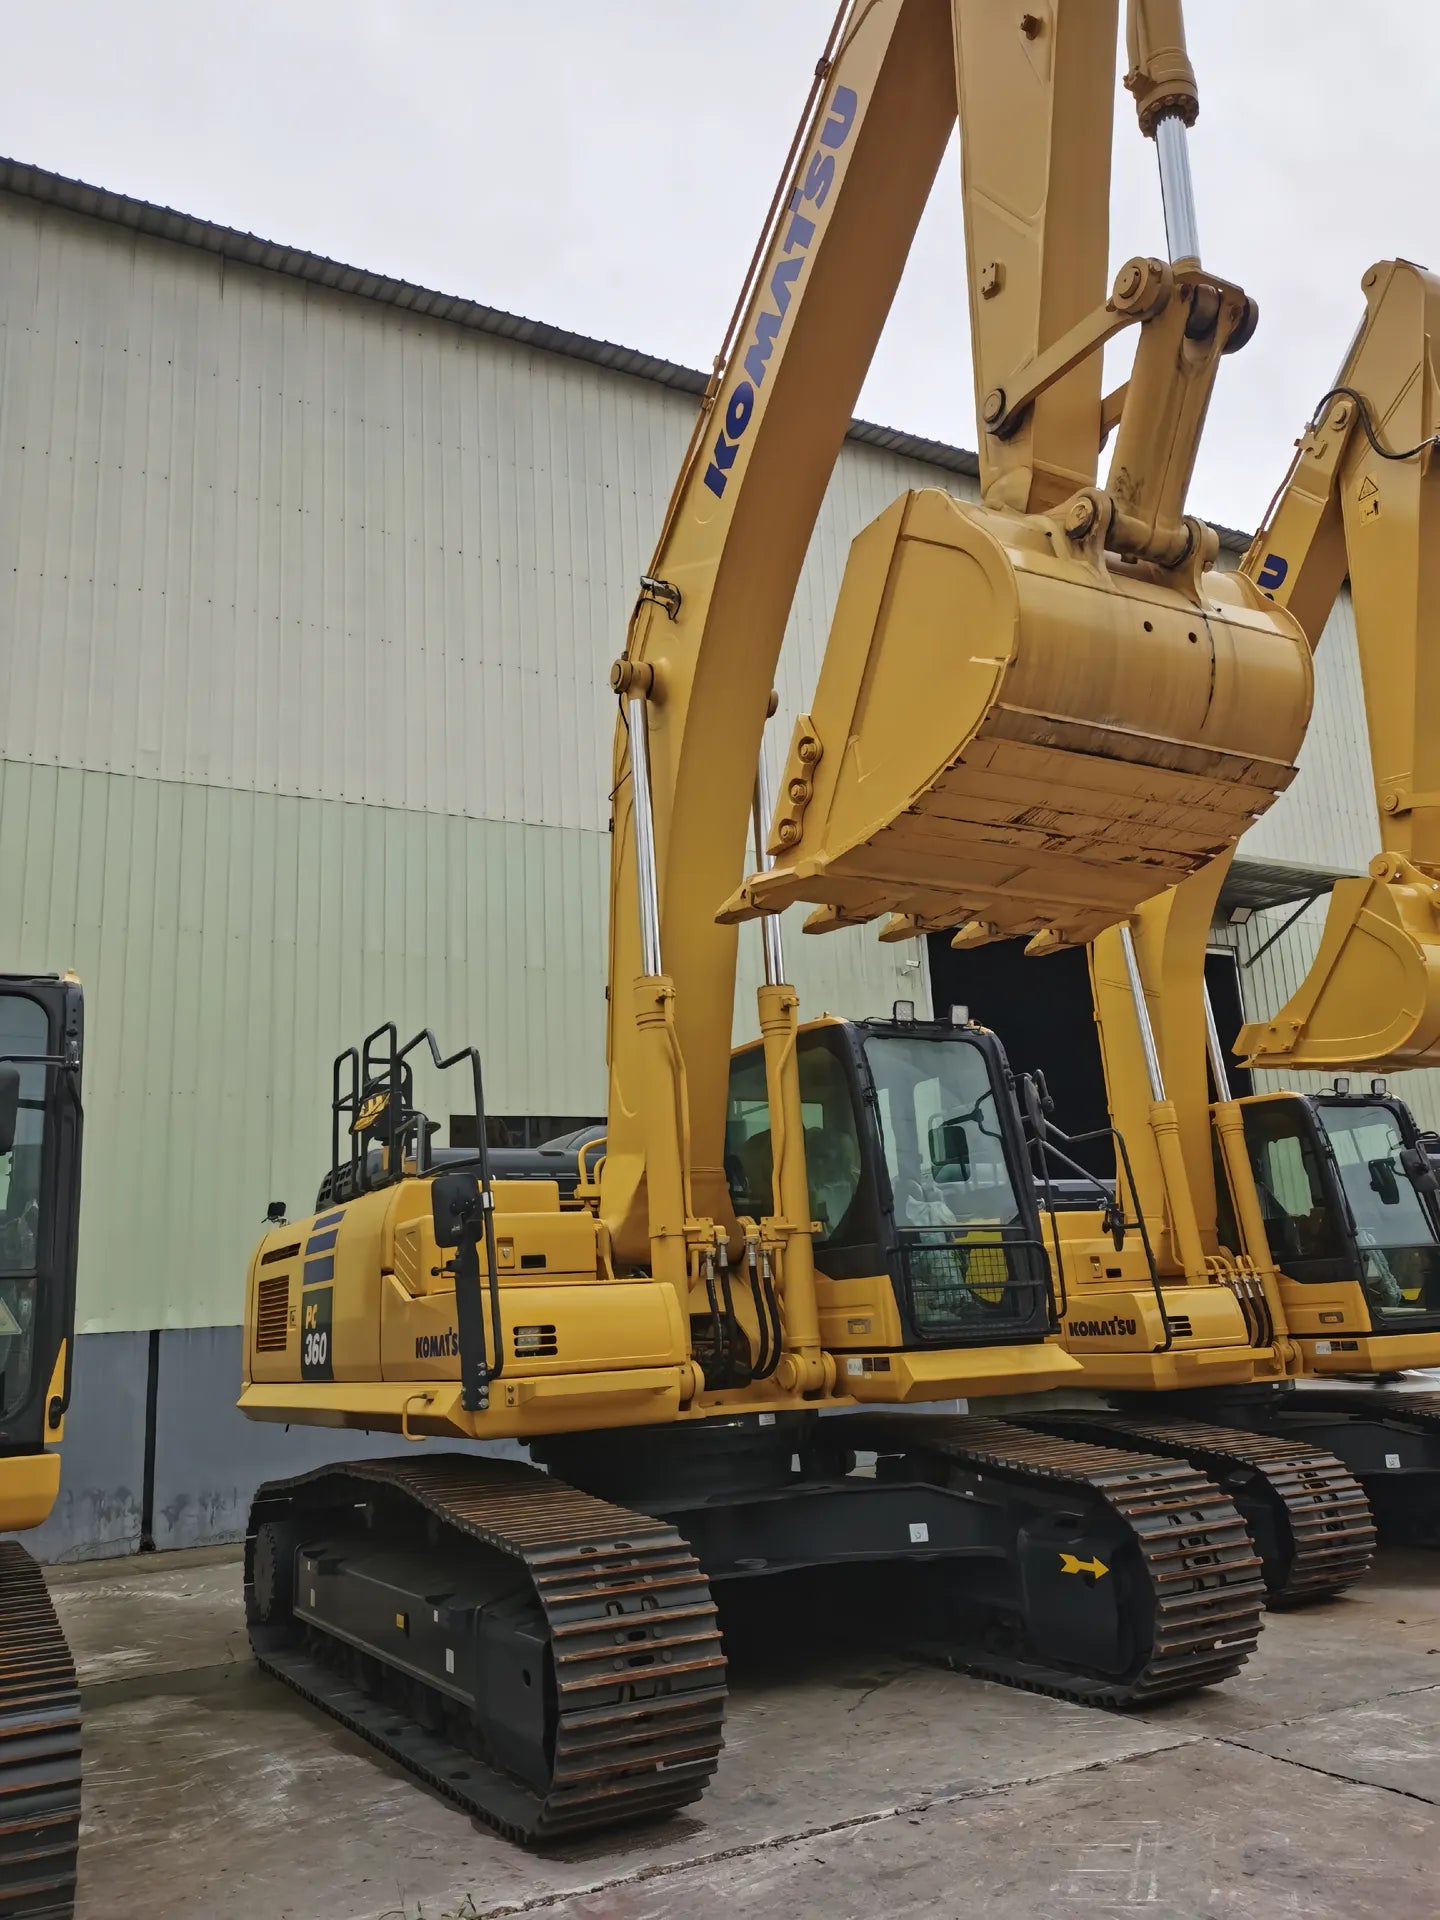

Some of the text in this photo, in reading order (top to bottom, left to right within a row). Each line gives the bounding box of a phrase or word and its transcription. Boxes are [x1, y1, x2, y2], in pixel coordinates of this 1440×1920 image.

[703, 85, 858, 499] KOMATSU
[1257, 553, 1288, 601] U
[305, 1304, 318, 1329] PC
[1068, 1315, 1137, 1337] KOMATSU
[304, 1331, 327, 1366] 360
[415, 1326, 459, 1359] KOMATS
